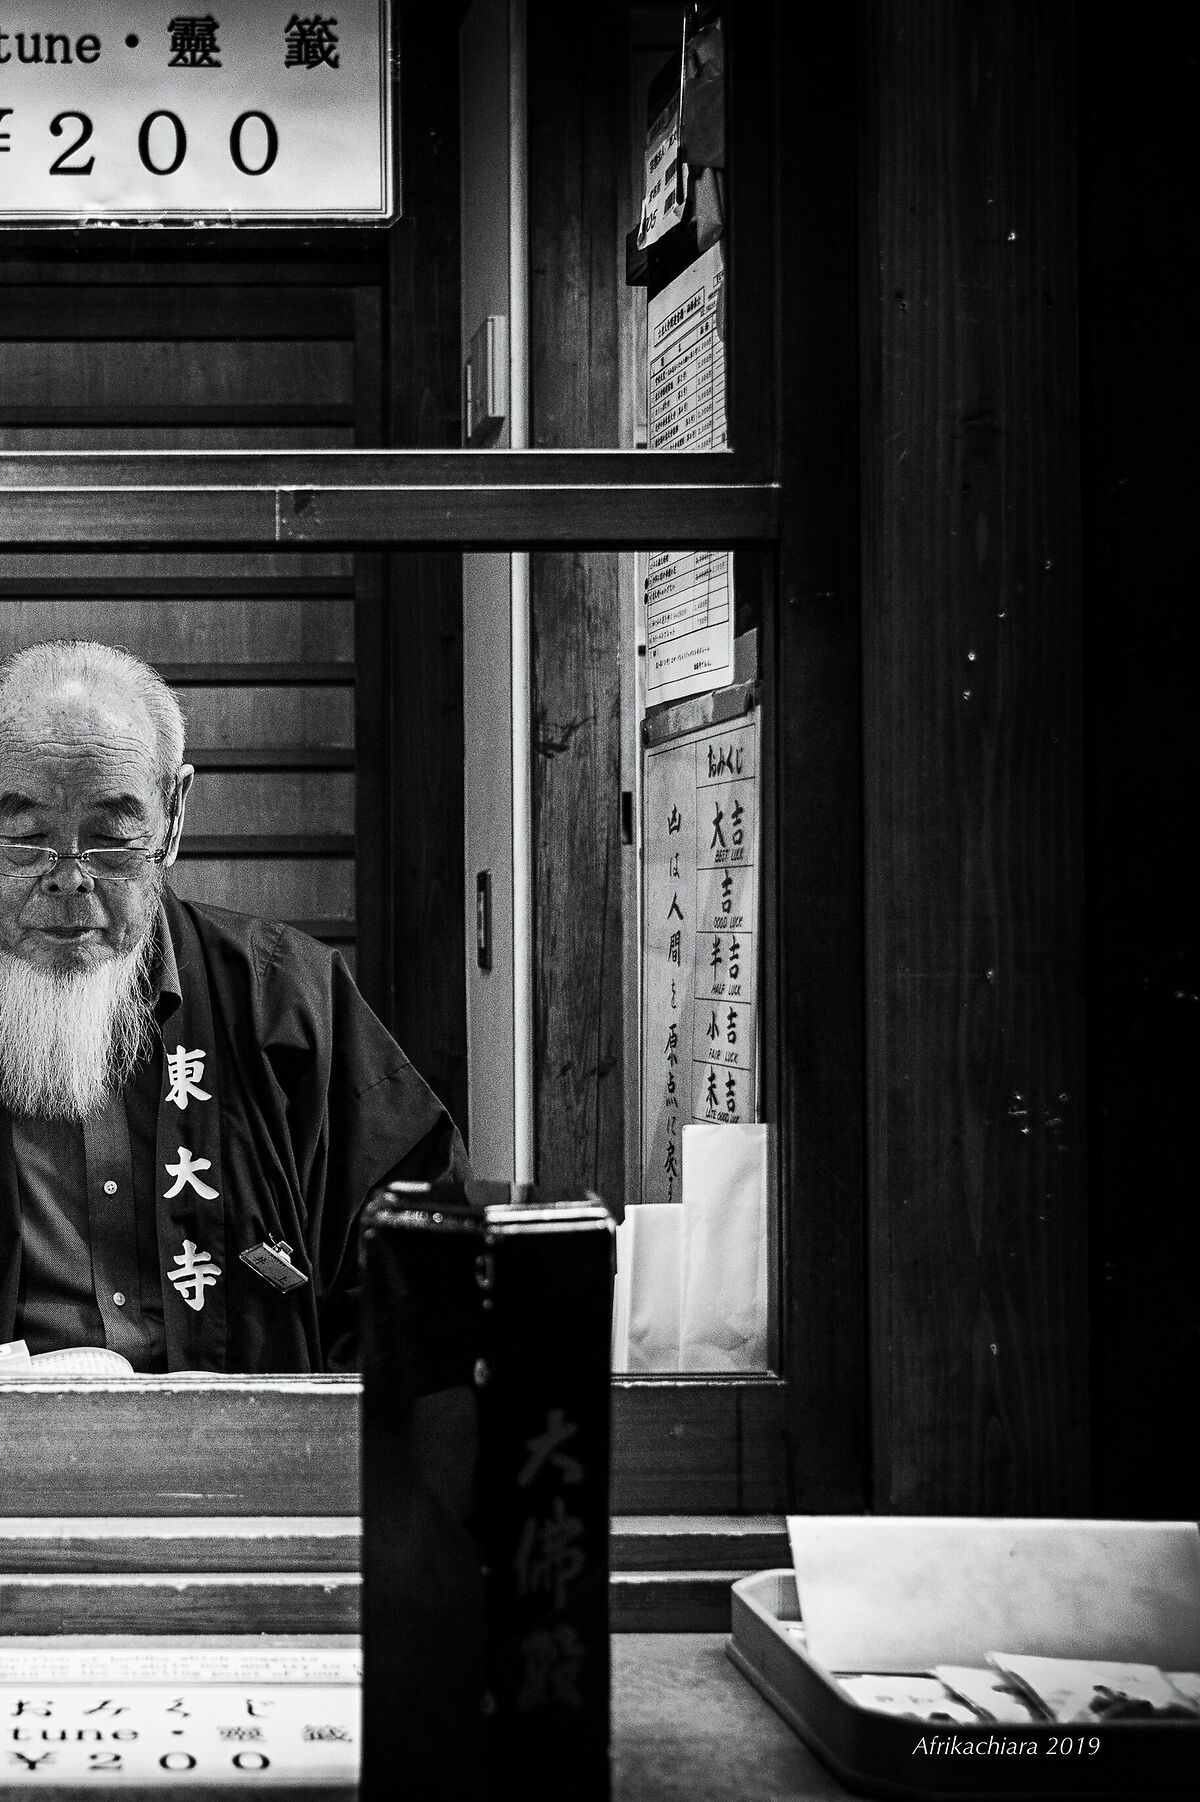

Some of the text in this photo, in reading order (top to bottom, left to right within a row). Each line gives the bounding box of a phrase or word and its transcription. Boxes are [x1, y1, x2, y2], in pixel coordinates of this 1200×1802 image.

[710, 799, 744, 850] 大吉
[714, 848, 744, 863] BEST LUCK
[721, 868, 733, 914] 吉
[713, 916, 743, 929] GOOD LUCK
[709, 933, 740, 980] 半吉
[711, 983, 741, 997] HALF LUCK
[706, 1005, 738, 1045] 小吉
[162, 1044, 222, 1312] 東大寺
[7, 1750, 272, 1771] ¥200
